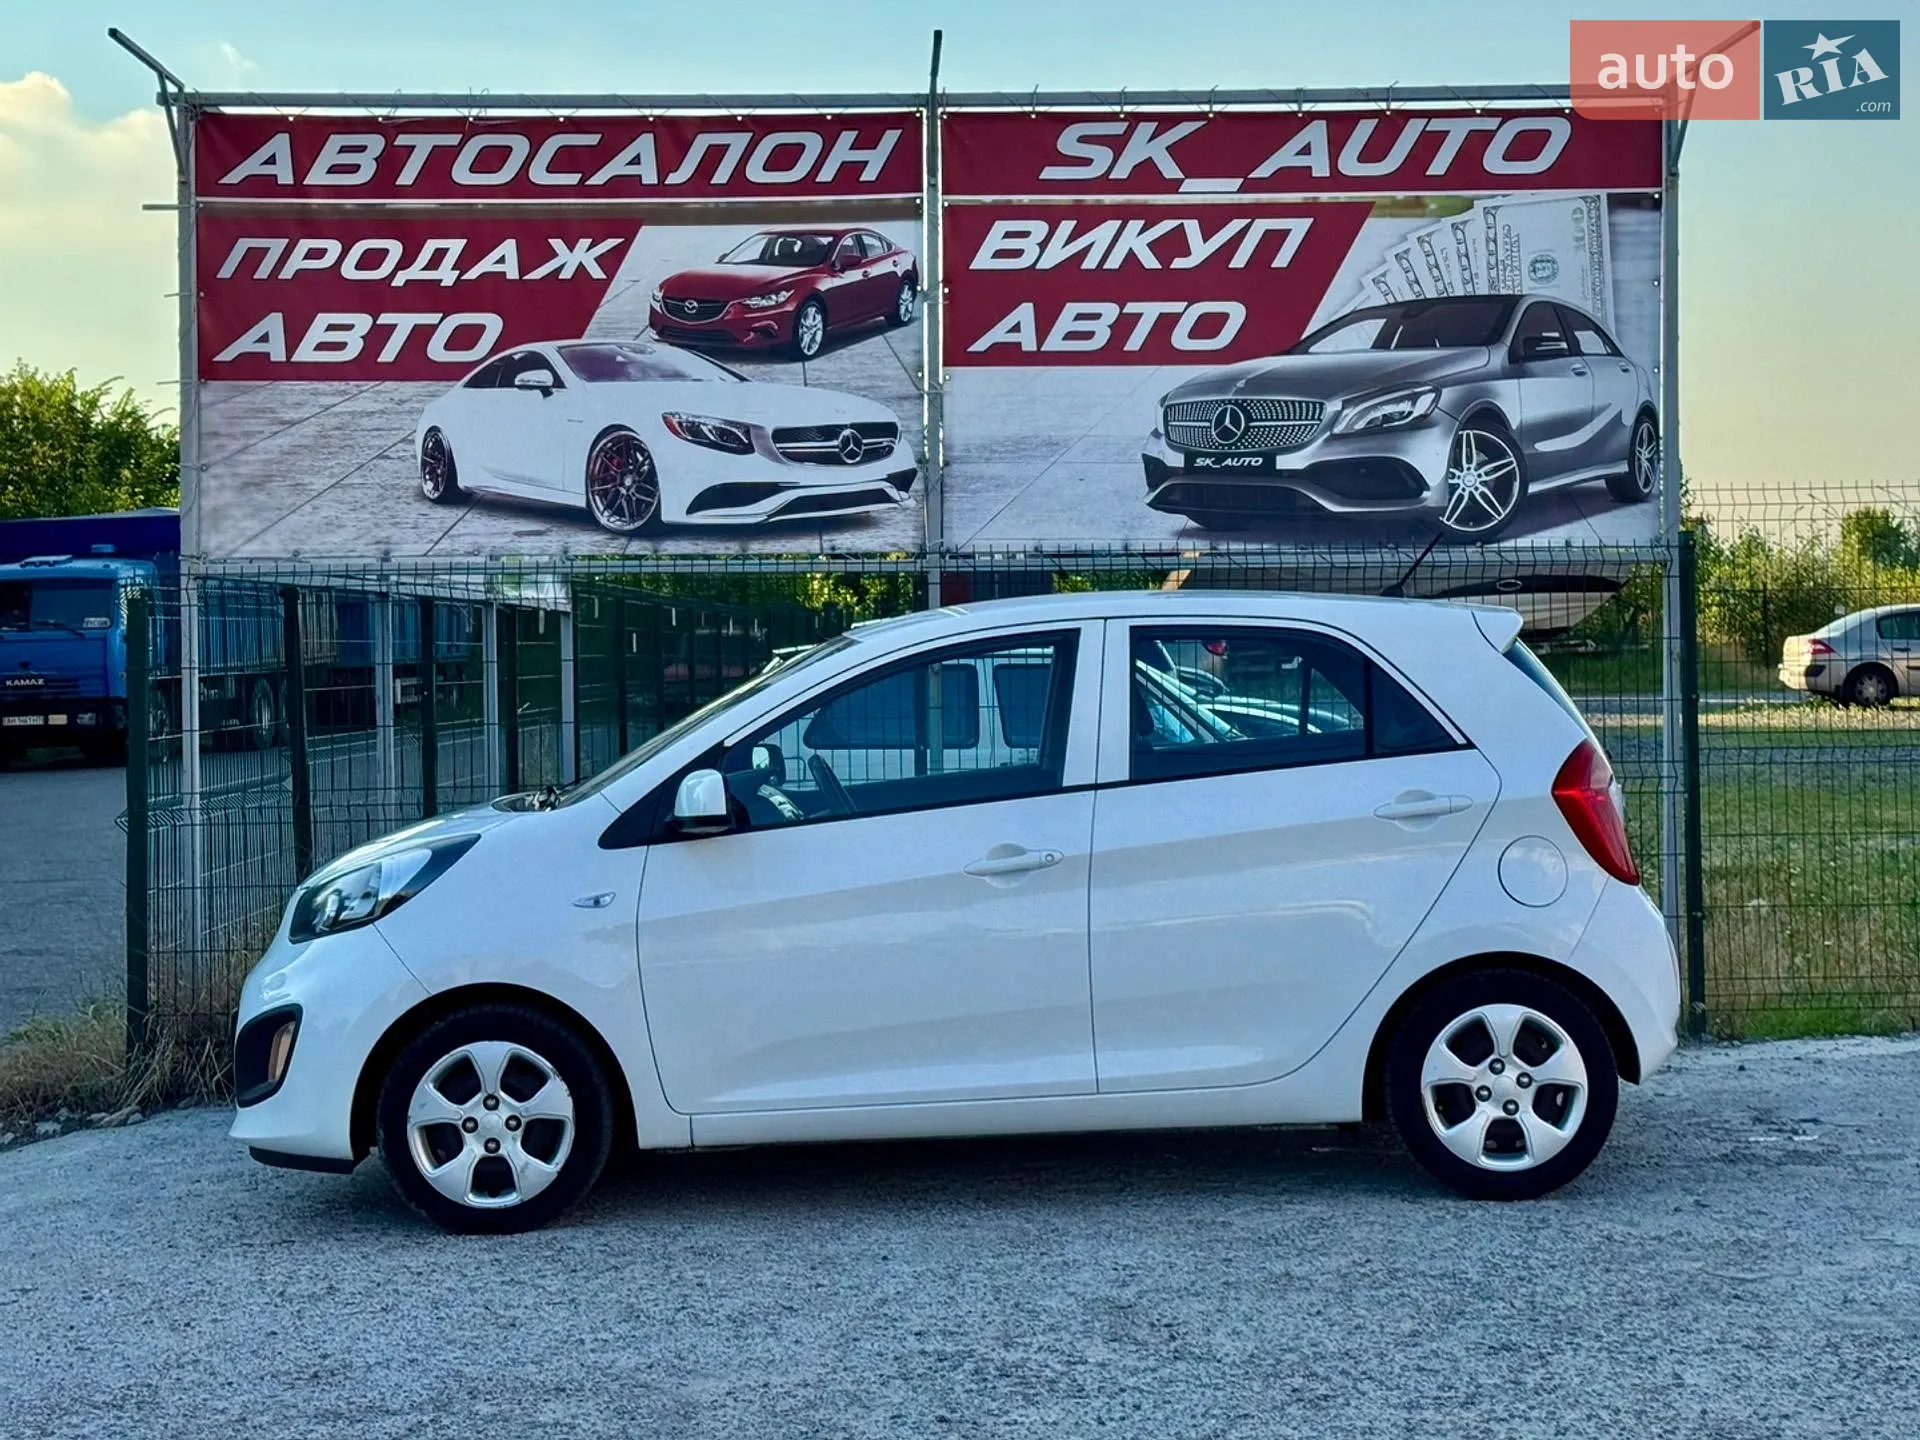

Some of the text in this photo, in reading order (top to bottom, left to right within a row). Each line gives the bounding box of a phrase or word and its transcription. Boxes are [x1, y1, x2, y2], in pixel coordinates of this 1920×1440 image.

[216, 129, 904, 186] АВТОСАЛОН
[1038, 116, 1572, 193] SK_AUTO
[216, 237, 626, 287] ПРОДАЖ
[968, 217, 1315, 270] ВИКУП
[211, 311, 504, 363] АВТО
[965, 301, 1247, 352] АВТО
[1194, 457, 1264, 468] SK_AUTO
